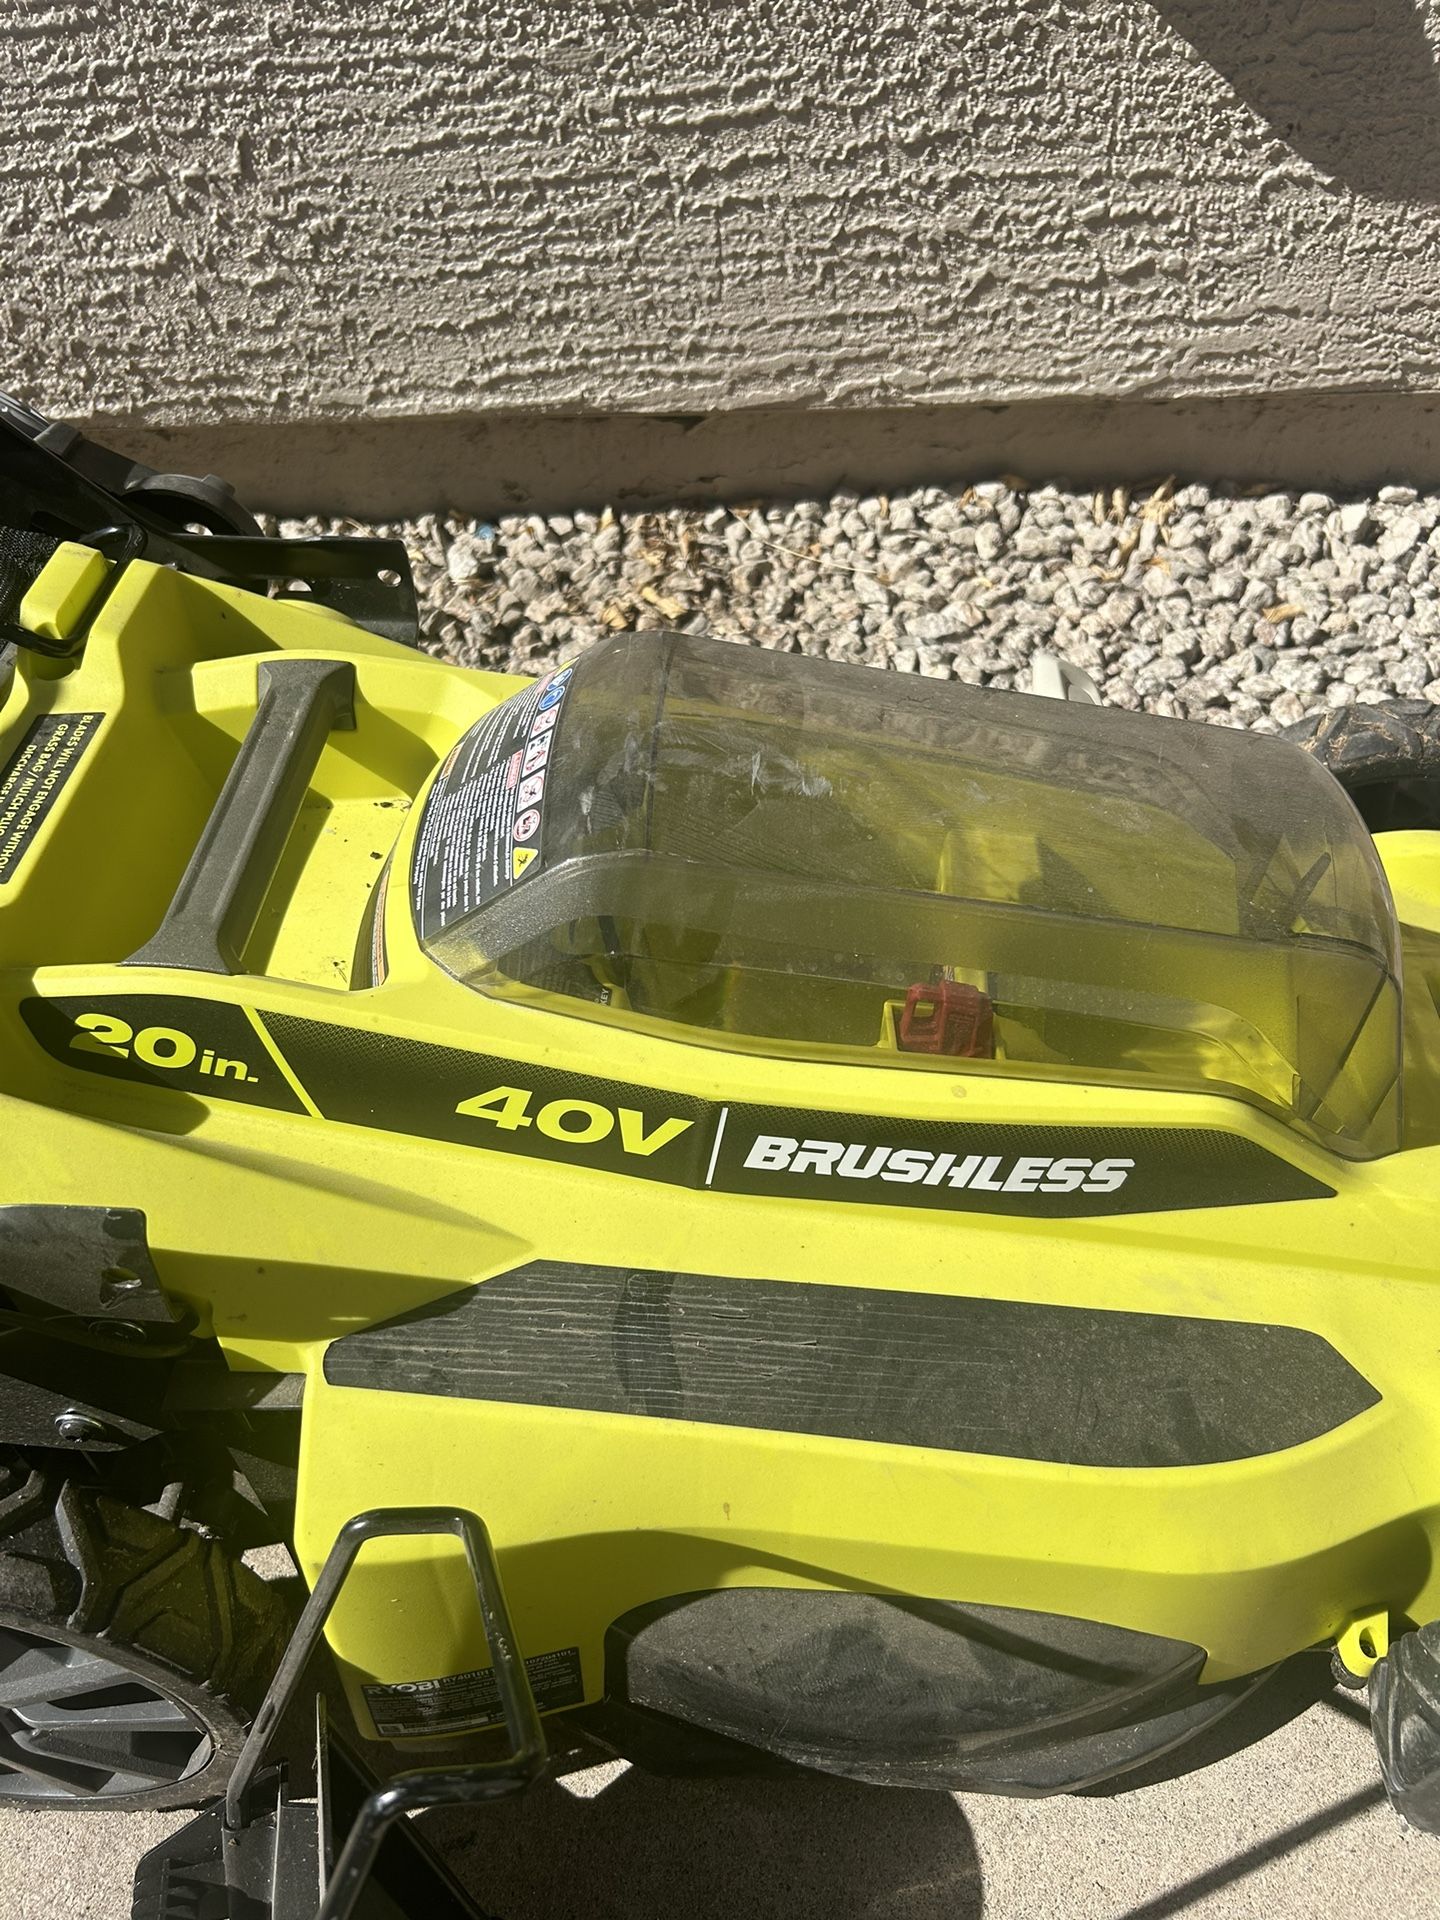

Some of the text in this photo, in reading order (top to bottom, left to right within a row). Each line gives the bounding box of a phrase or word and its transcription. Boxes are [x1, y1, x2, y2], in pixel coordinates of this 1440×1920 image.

[45, 724, 69, 752] GRASS
[67, 715, 94, 746] BLADES
[0, 744, 38, 796] DISCHARGE
[32, 753, 52, 772] BAG
[53, 748, 75, 768] WILL
[8, 778, 37, 809] MULCH
[41, 770, 61, 790] NOT
[17, 791, 49, 830] ENGAGE
[455, 1086, 695, 1156] 40V
[743, 1135, 1135, 1192] BRUSHLESS
[366, 1680, 440, 1695] RYOBI
